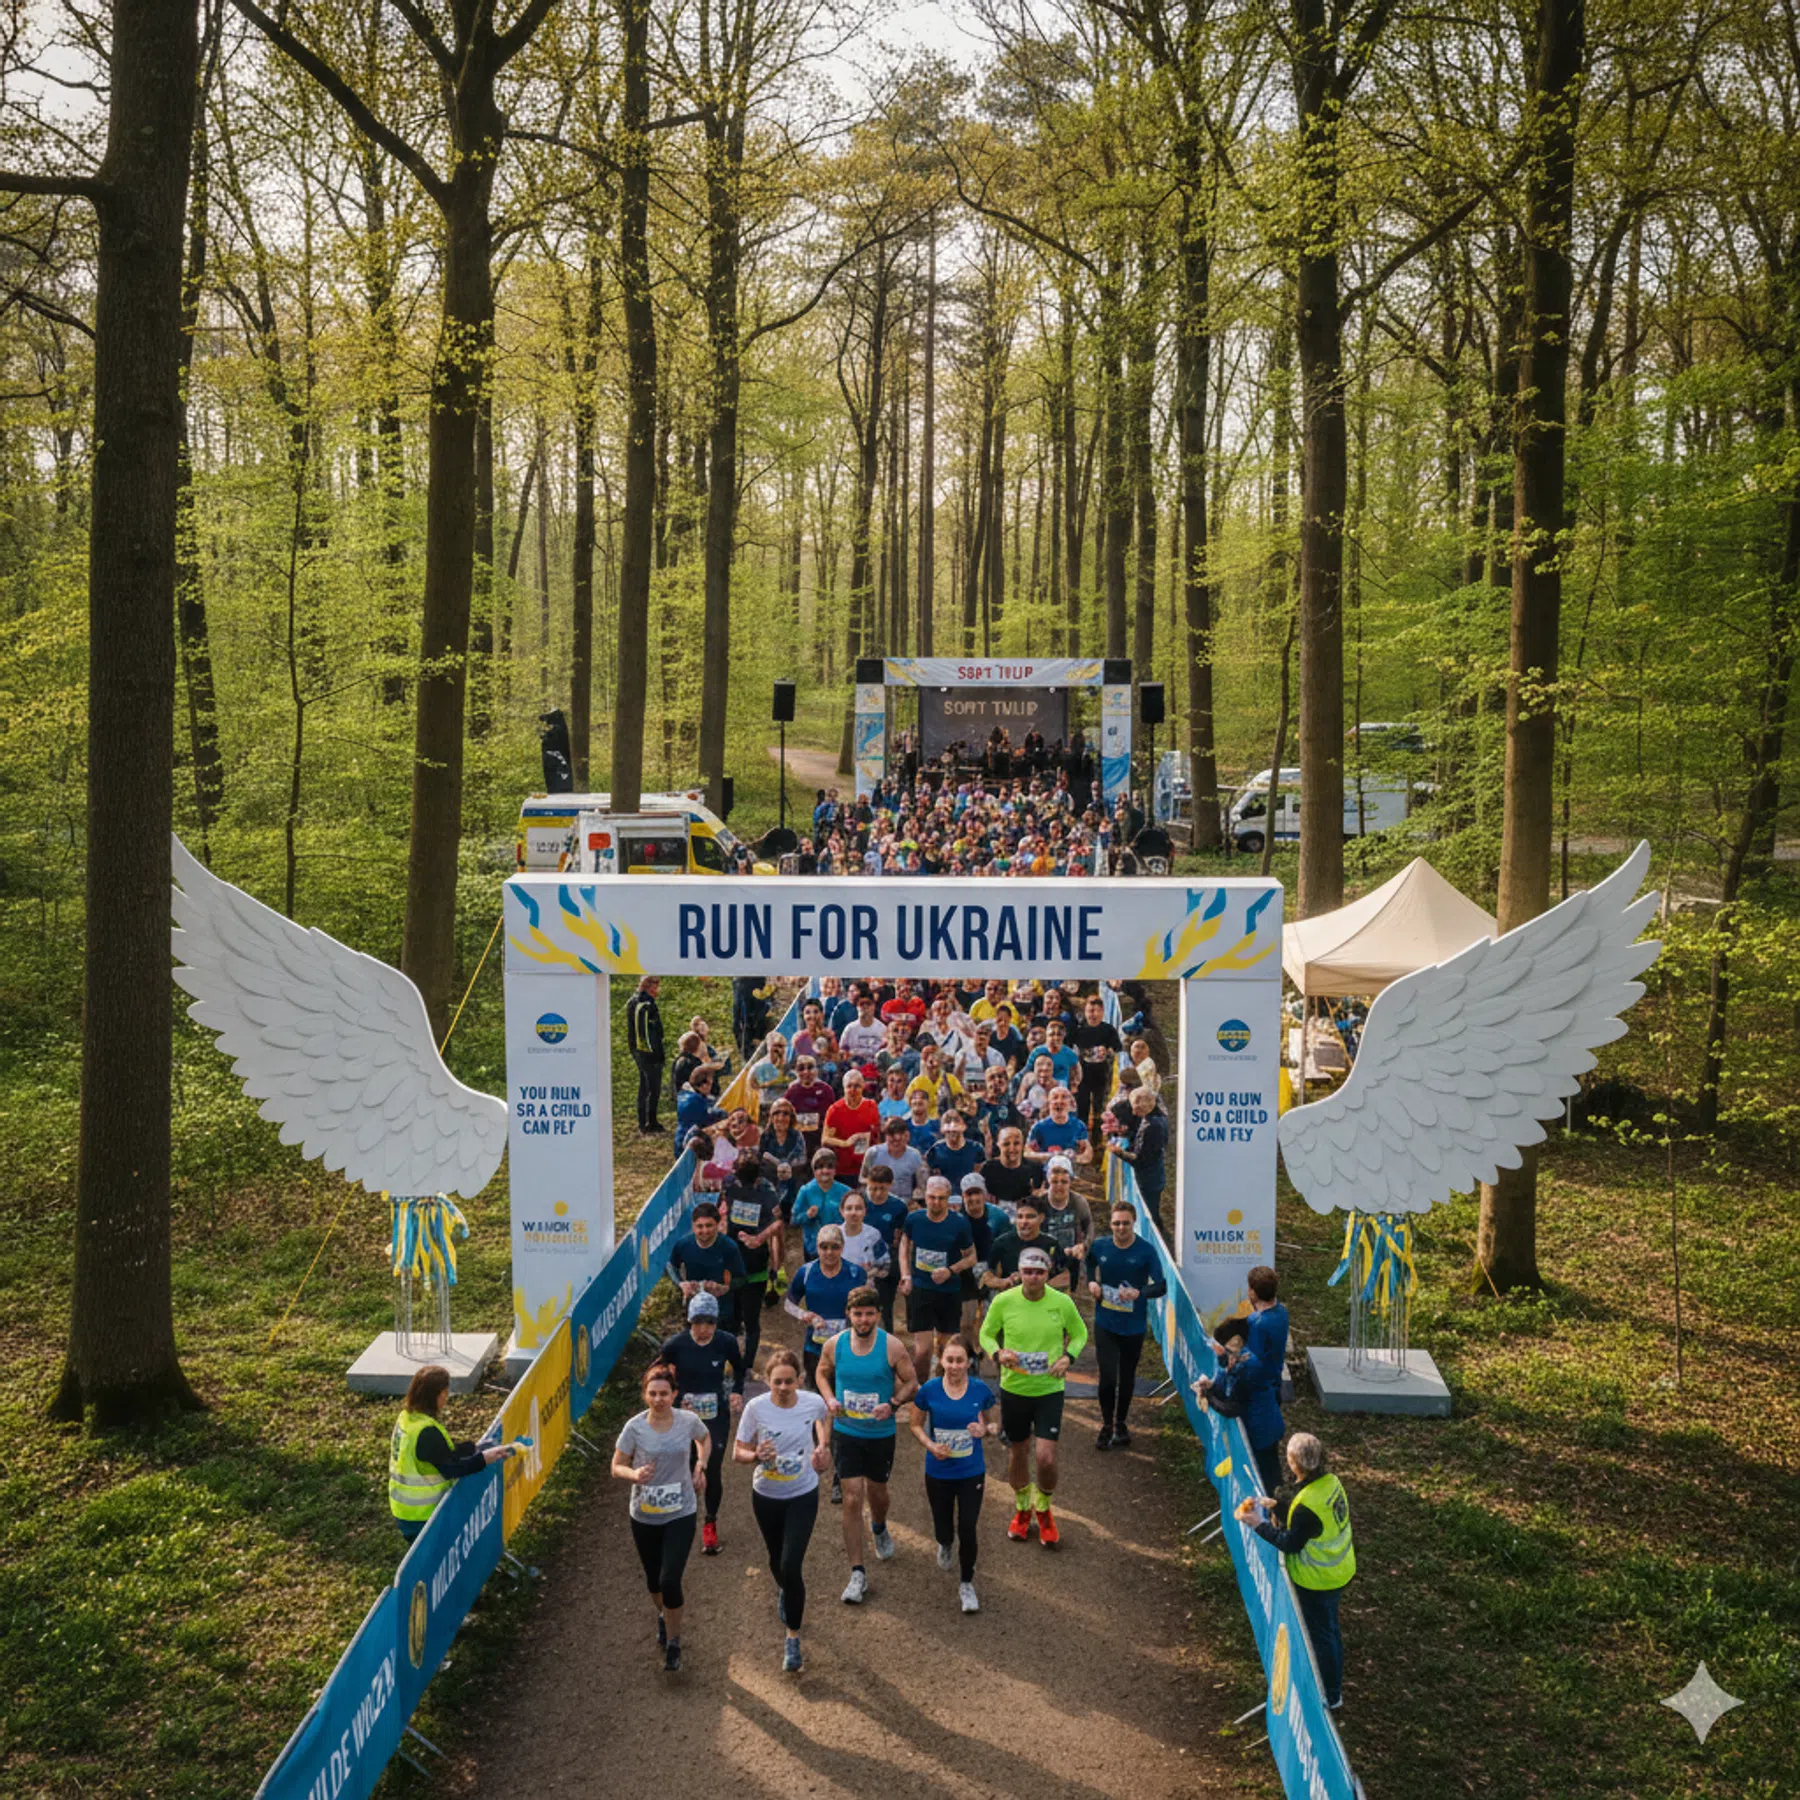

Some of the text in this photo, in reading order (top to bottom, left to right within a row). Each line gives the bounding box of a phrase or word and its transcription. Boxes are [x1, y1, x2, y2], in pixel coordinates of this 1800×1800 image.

[678, 903, 1104, 961] RUN FOR UKRAINE
[519, 1086, 547, 1100] YOU
[1194, 1091, 1225, 1106] YOU
[538, 1103, 548, 1117] A
[1191, 1108, 1211, 1123] SO
[522, 1120, 550, 1135] CAN
[1196, 1126, 1226, 1142] CAN
